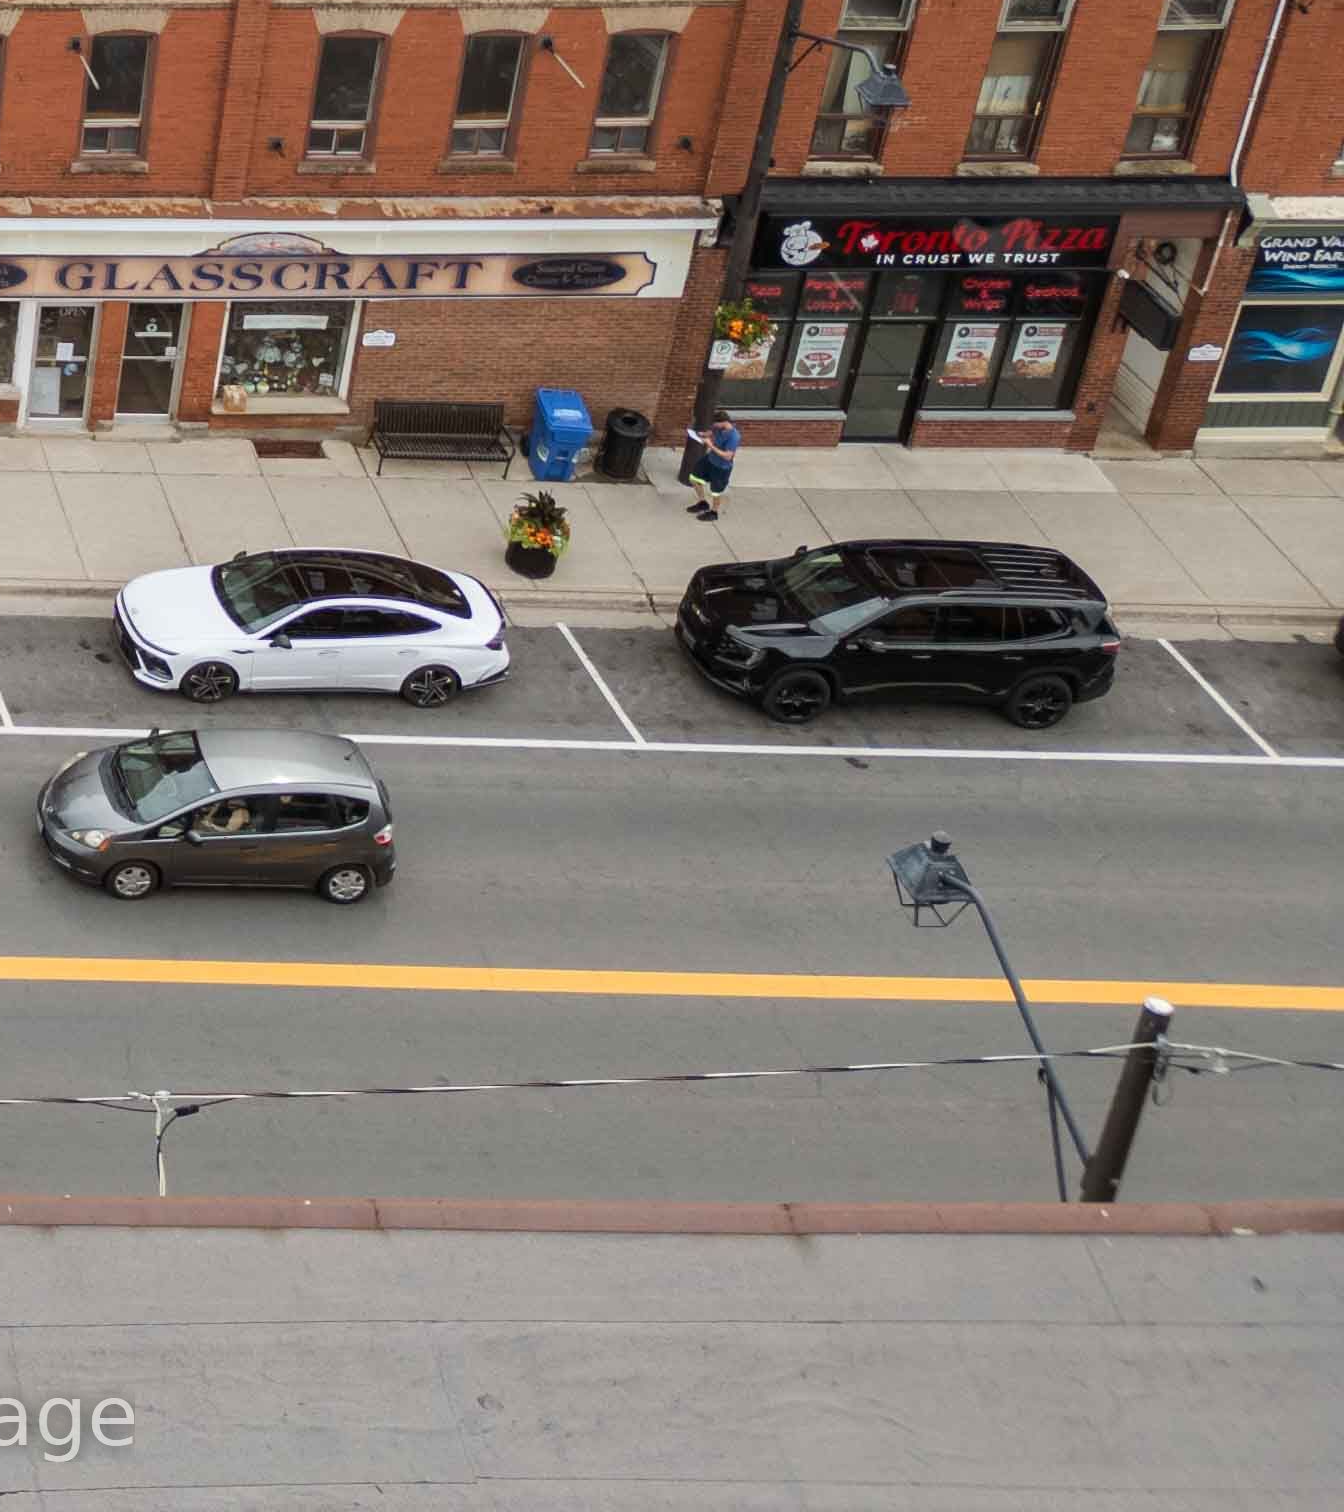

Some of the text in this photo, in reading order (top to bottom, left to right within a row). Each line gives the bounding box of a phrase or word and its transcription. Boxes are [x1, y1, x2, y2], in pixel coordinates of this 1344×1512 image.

[837, 217, 1109, 255] Toronto Pizza
[1260, 236, 1318, 248] GRAND
[876, 253, 1061, 265] IN CRUST WE TRUST
[1264, 250, 1311, 262] WIND
[54, 261, 484, 291] GLASSCRAFT
